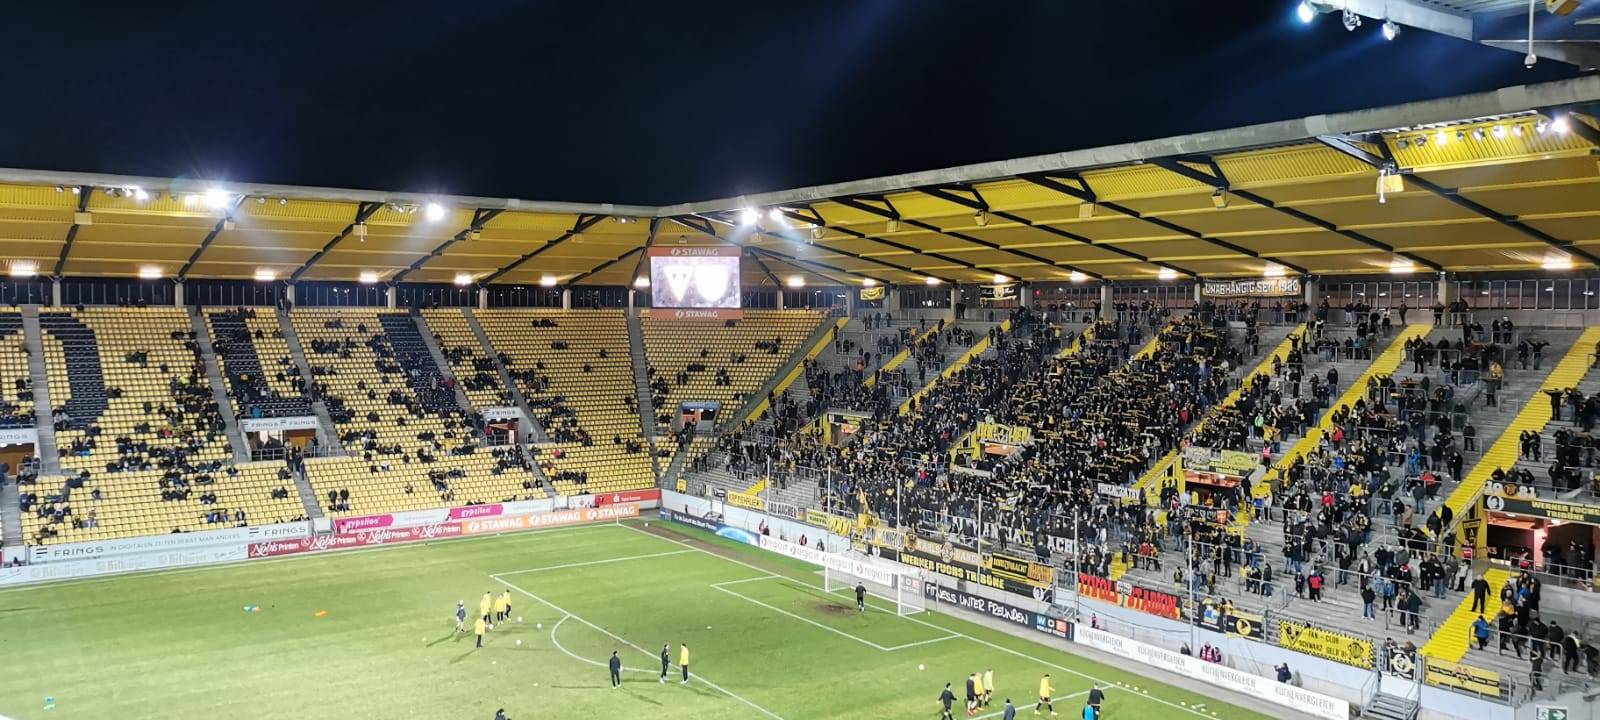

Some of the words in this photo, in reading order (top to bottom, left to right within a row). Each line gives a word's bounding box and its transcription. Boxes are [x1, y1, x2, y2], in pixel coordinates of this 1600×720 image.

[681, 247, 718, 256] STAWAG
[685, 310, 718, 318] STAWAG
[598, 506, 635, 518] STAWAG
[1531, 501, 1569, 512] WERNER
[481, 516, 523, 529] STAWAG
[541, 512, 581, 524] STAWAG
[264, 527, 306, 537] FRINGS
[54, 546, 105, 557] FRINGS
[900, 552, 935, 571] WERNER
[935, 562, 964, 579] FUCHS
[959, 594, 985, 612] UNTER
[987, 601, 1029, 625] FREUNDEN
